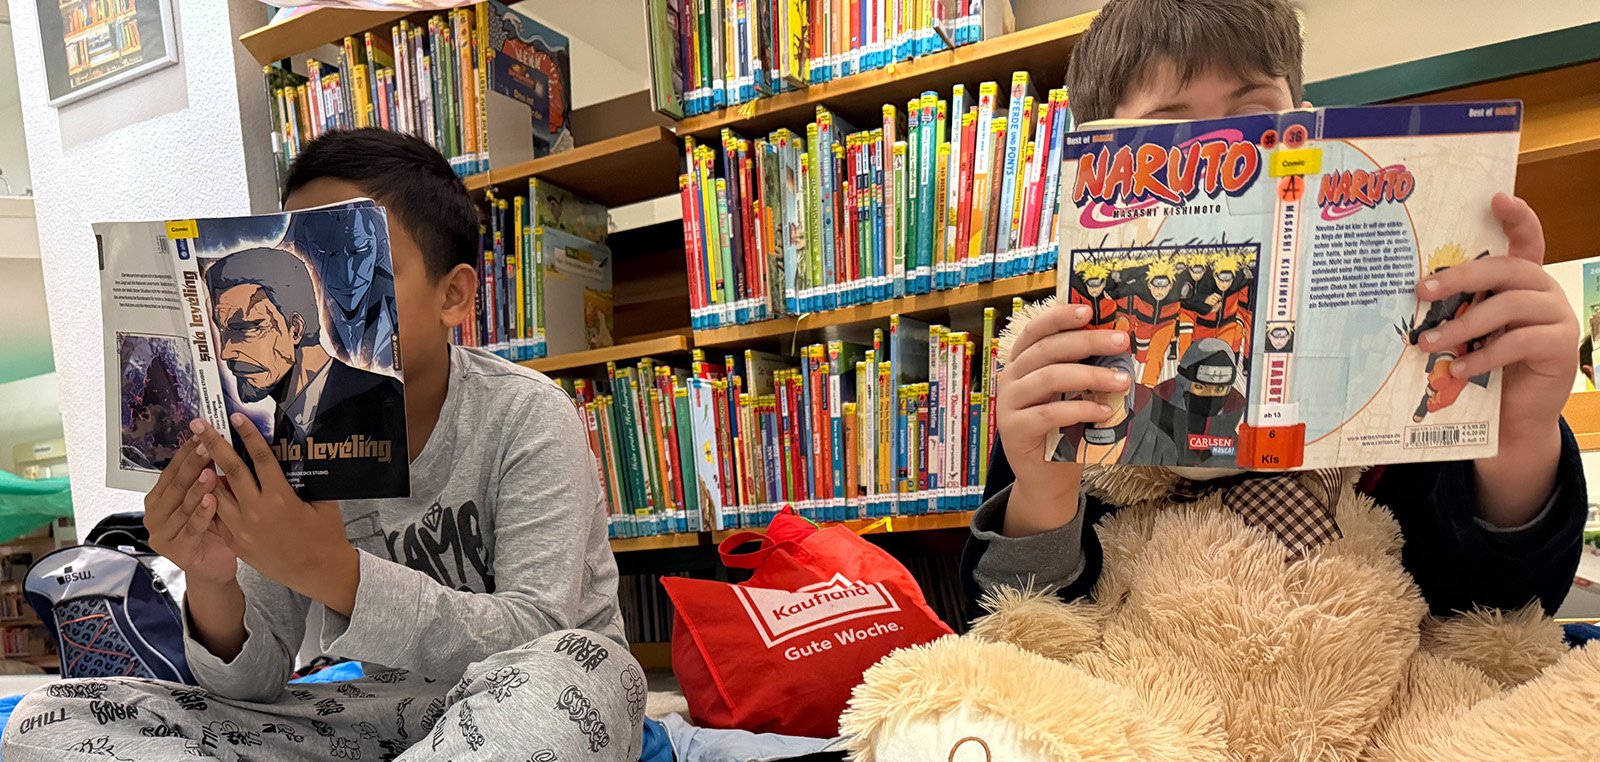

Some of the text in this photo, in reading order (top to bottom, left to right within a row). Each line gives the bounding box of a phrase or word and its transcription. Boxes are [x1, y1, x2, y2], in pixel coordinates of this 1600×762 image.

[1010, 97, 1021, 129] PFERDE
[1469, 108, 1484, 117] Best
[1066, 136, 1082, 145] Best
[1288, 130, 1302, 143] 36
[1006, 146, 1016, 176] PONYS
[1073, 140, 1261, 207] NARUTO
[1318, 168, 1415, 209] NARUTO
[1113, 204, 1221, 218] MASASHI KISHIMOTO
[1278, 205, 1294, 316] MASASHI KISHIMOTO
[182, 271, 214, 362] solo leveling
[1269, 360, 1284, 404] NARUT
[271, 434, 392, 464] olo leveling
[1189, 437, 1232, 448] CARLSEN
[1269, 430, 1275, 439] 6
[1262, 454, 1279, 464] Kis
[772, 584, 869, 620] Kaufland
[784, 620, 904, 662] Gute Woche.
[20, 708, 72, 734] CHILL
